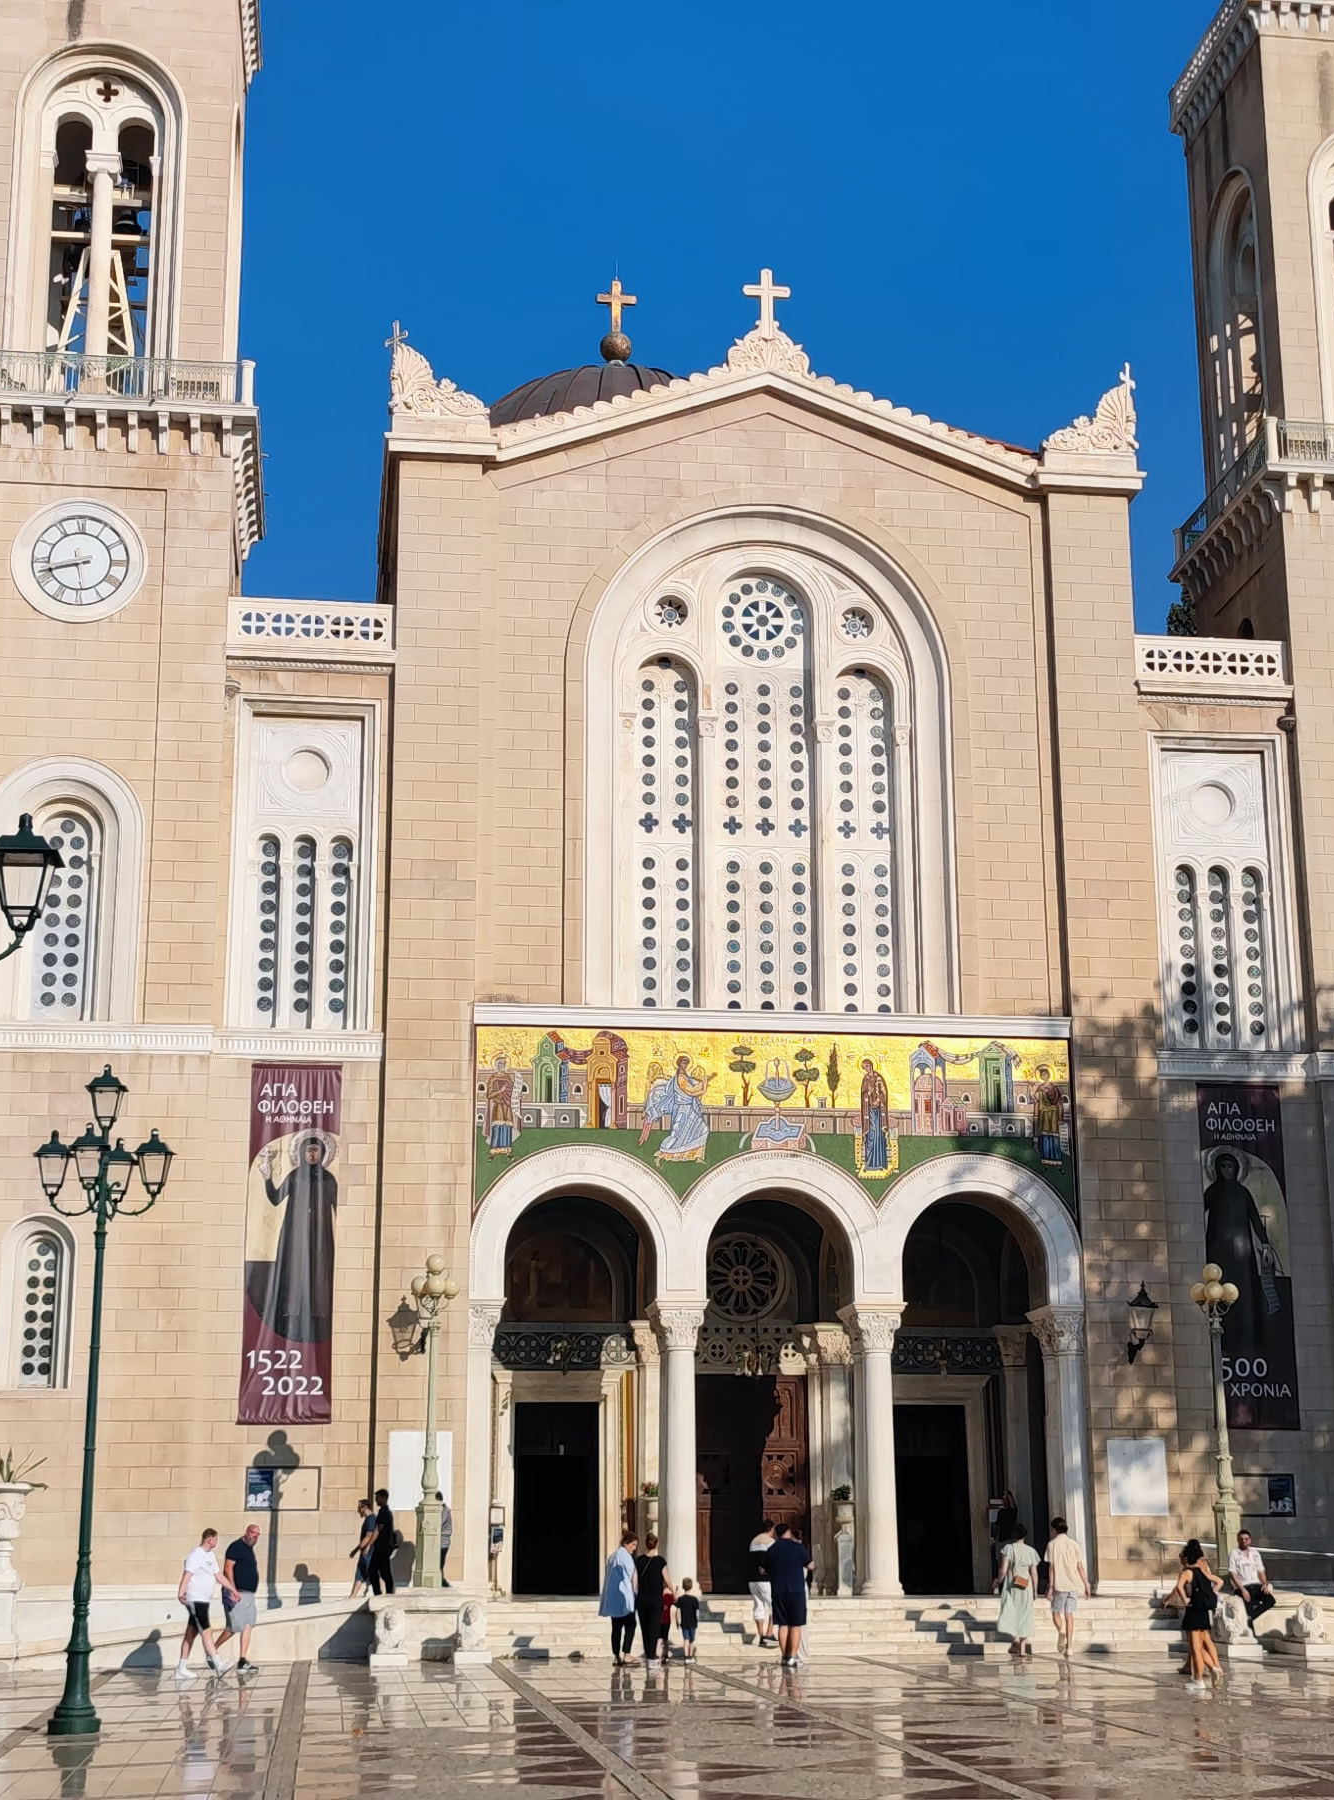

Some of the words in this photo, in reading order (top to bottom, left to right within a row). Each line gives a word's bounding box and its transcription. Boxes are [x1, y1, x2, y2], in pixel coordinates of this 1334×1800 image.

[260, 1083, 298, 1096] ΑΓΙΑ
[258, 1100, 334, 1114] ΦΙΛΟΘΕΗ
[1207, 1102, 1241, 1115] ΑΓΙΑ
[1206, 1118, 1275, 1132] ΦΙΛΟΘΕΗ
[246, 1350, 303, 1375] 1522
[1221, 1357, 1267, 1382] 500
[262, 1376, 323, 1395] 2022
[1230, 1382, 1292, 1398] ΧΡΟΝΙΑ
